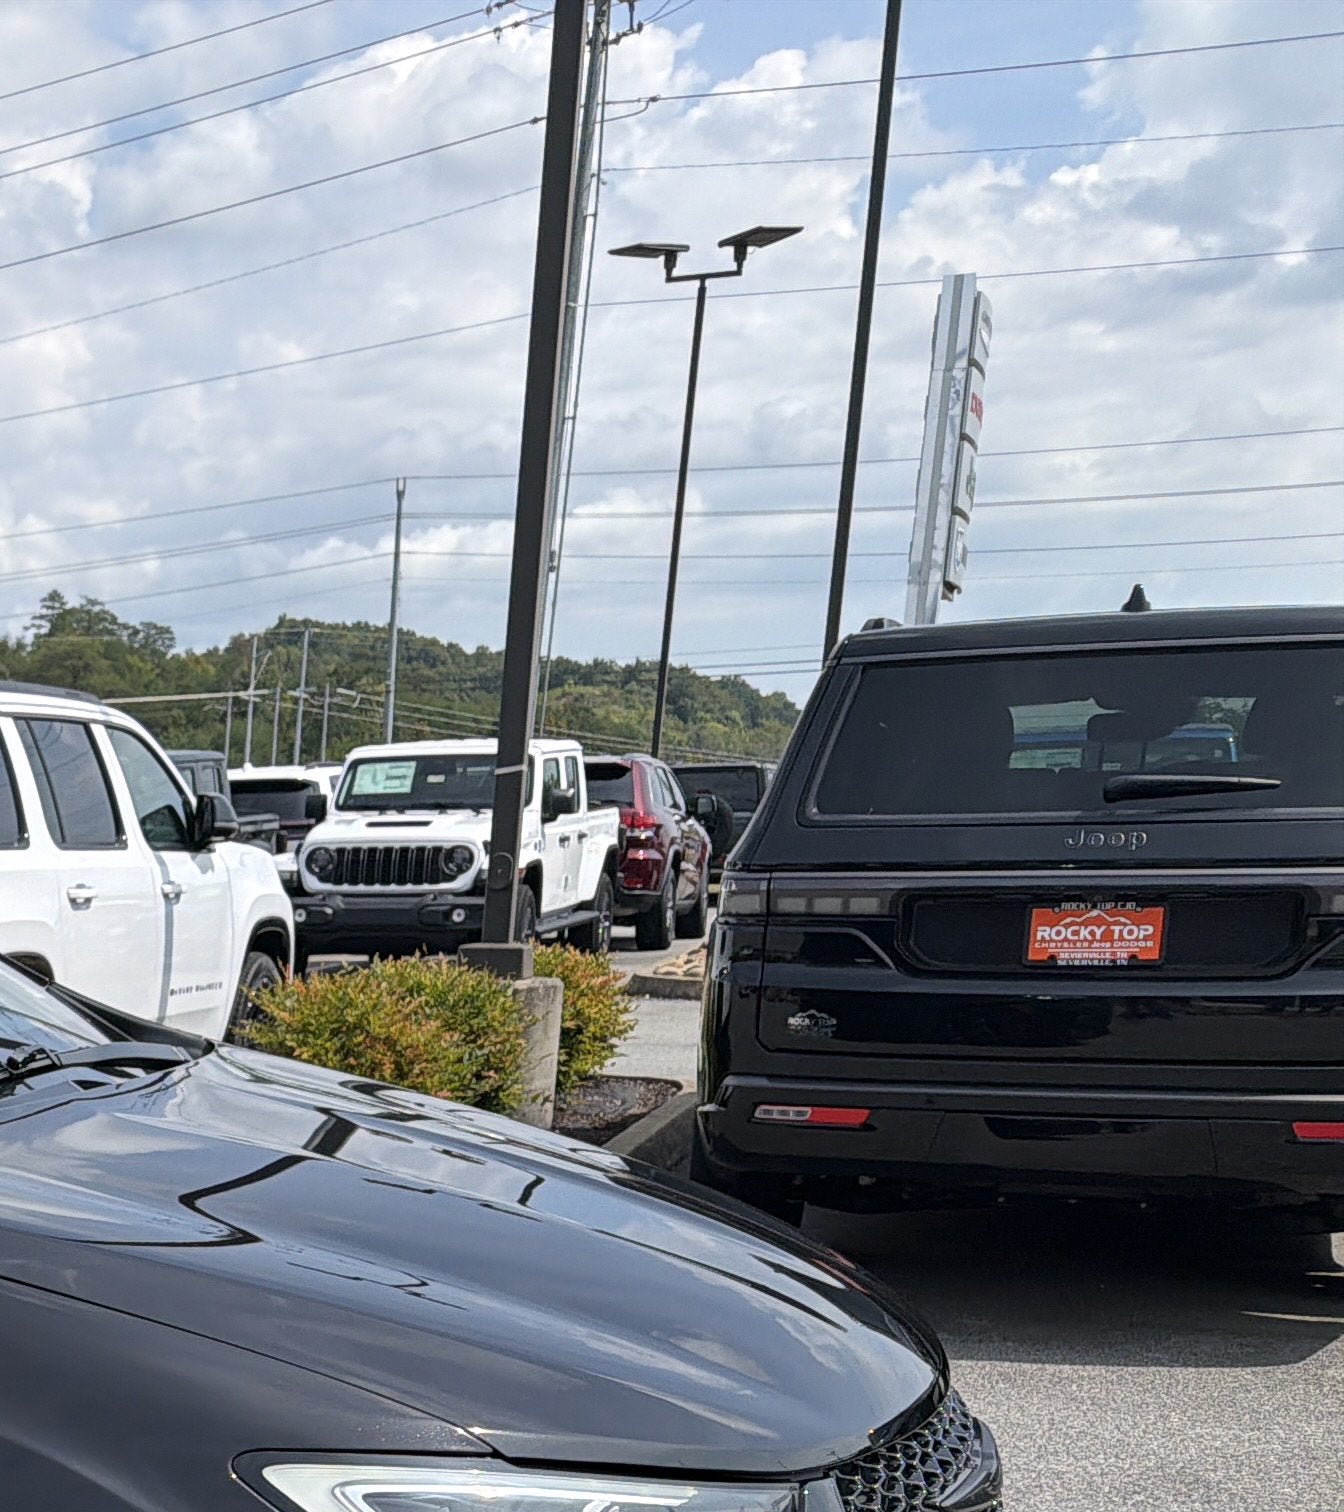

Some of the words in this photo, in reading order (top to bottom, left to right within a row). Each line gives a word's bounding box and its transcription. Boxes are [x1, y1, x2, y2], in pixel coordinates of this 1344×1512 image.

[1064, 829, 1147, 851] Jeep
[1061, 902, 1092, 910] ROCKY
[1036, 925, 1108, 940] ROCKY
[1109, 925, 1155, 940] TOP
[1113, 940, 1154, 948] DODGE
